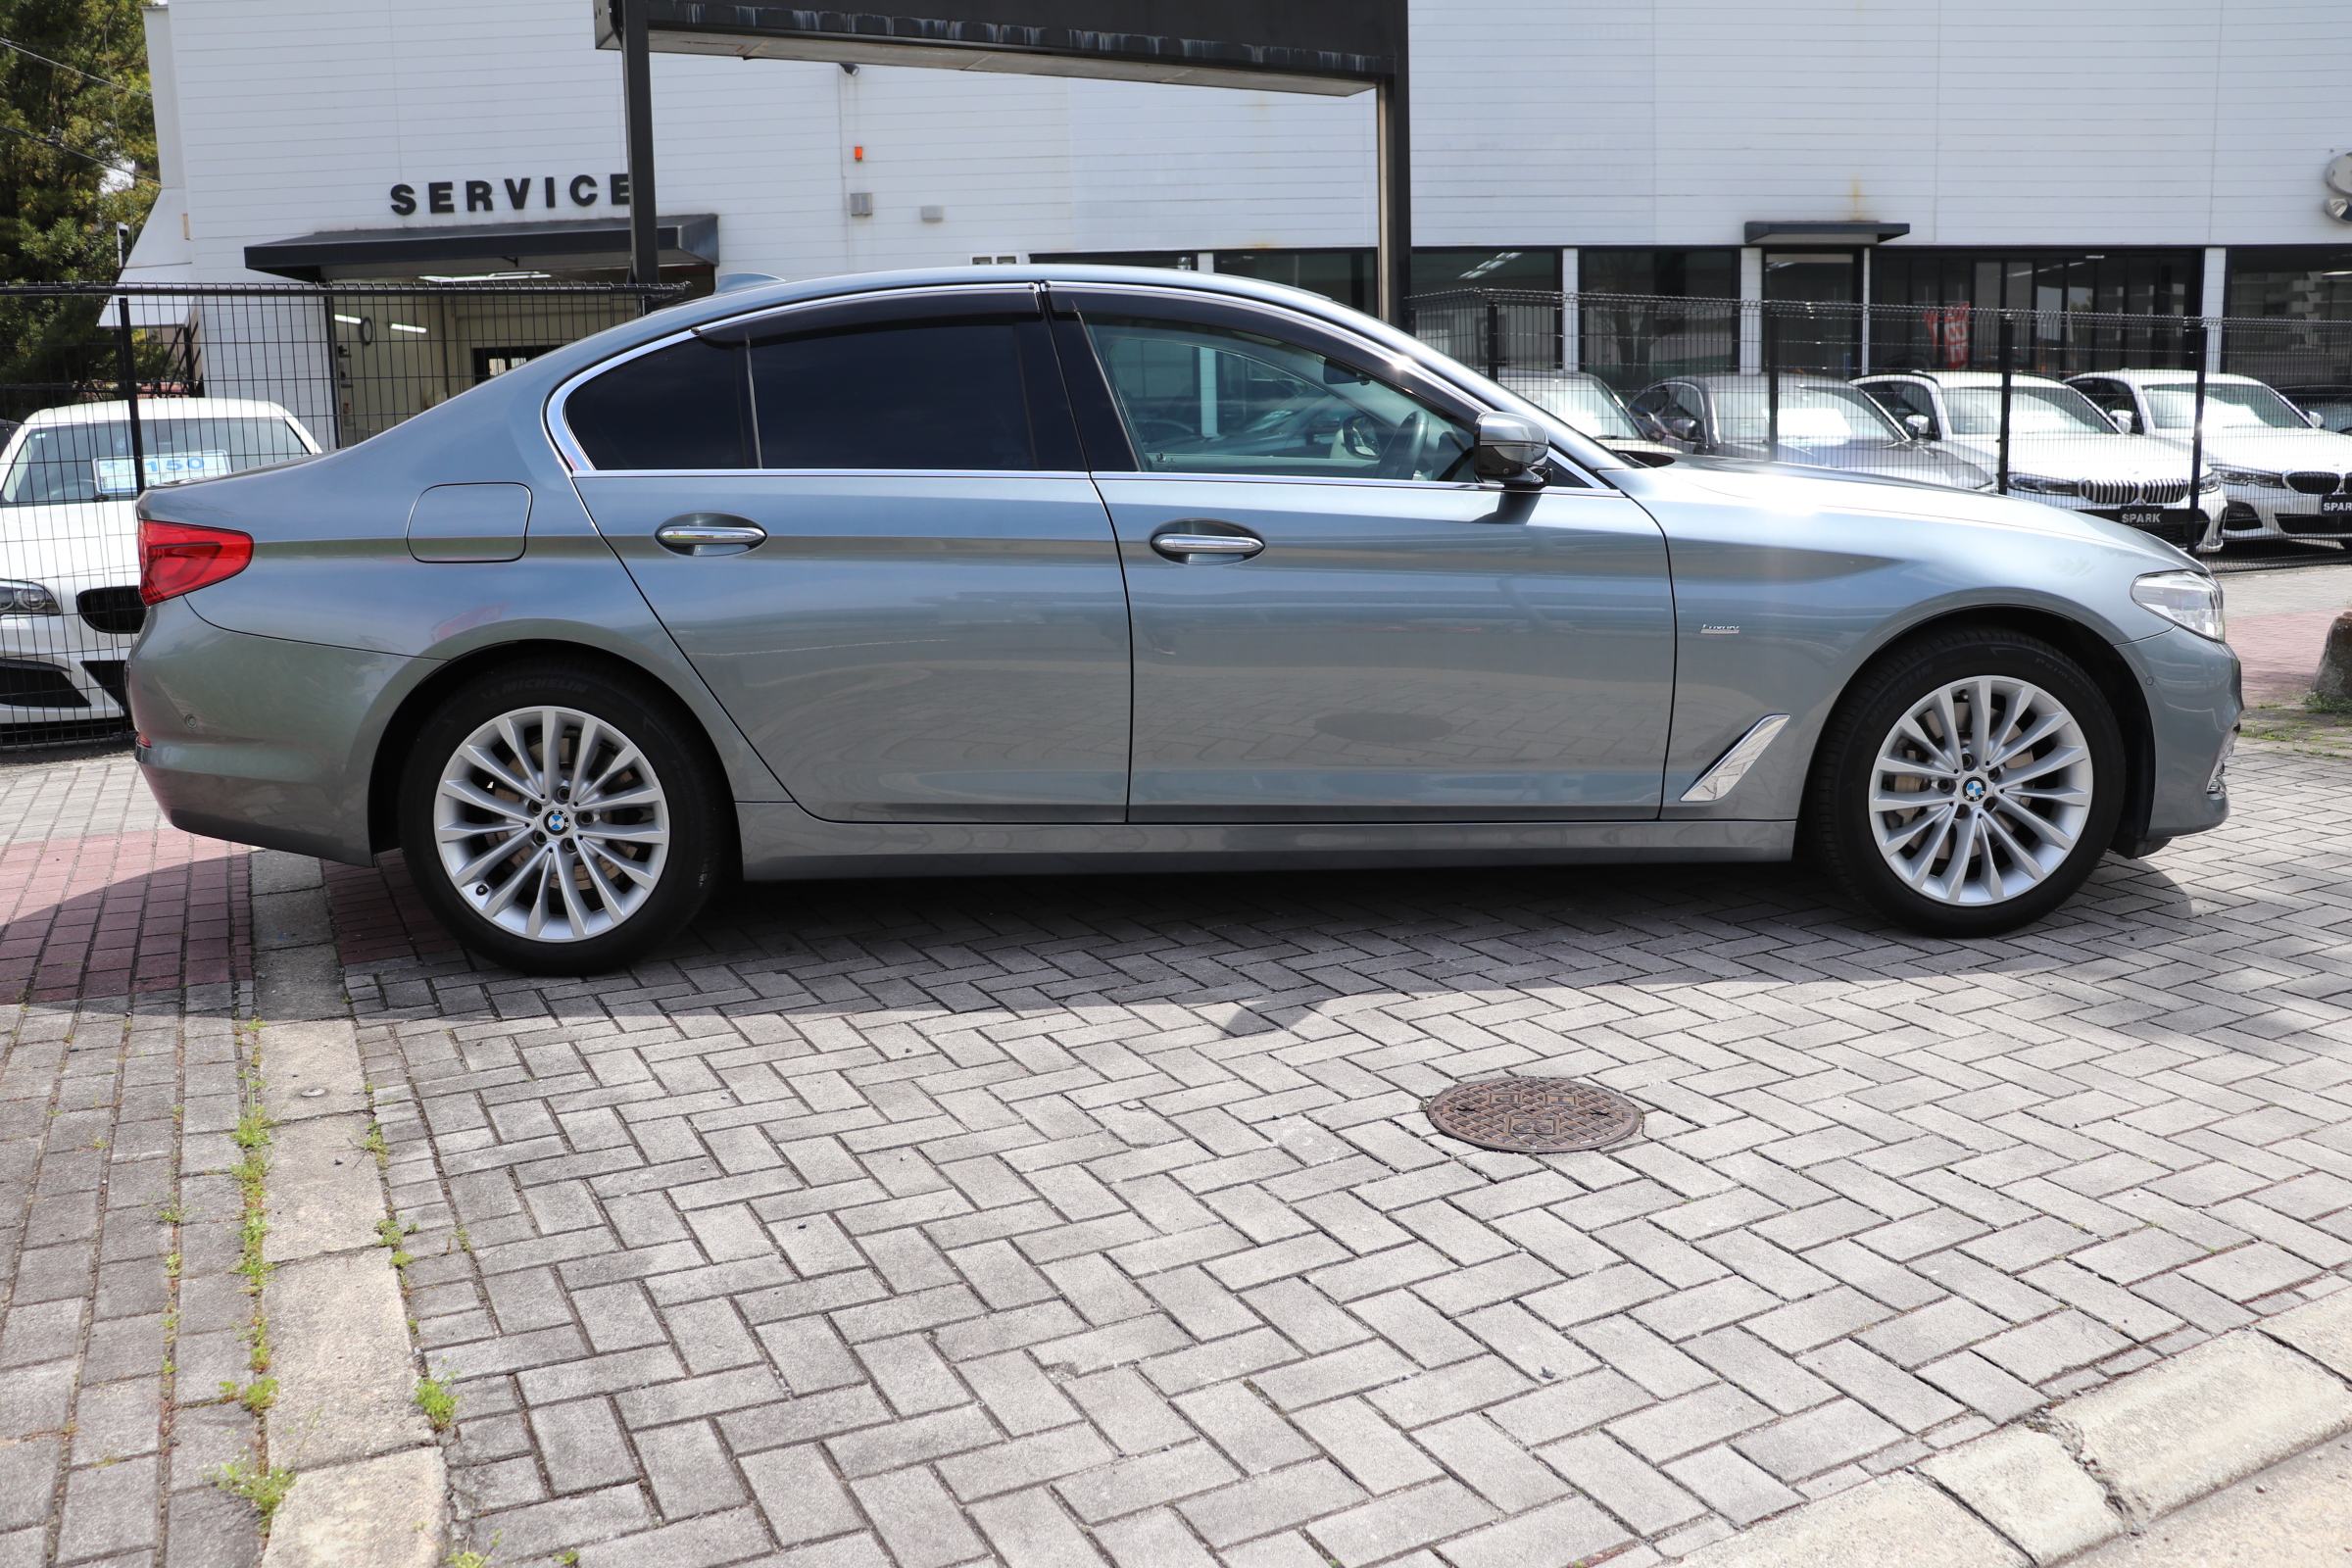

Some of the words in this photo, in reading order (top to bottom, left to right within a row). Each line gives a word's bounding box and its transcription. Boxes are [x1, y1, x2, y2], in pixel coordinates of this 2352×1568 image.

[390, 173, 629, 216] SERVICE
[146, 458, 205, 472] 150
[2122, 513, 2161, 523] SPARK
[502, 678, 590, 695] MICHELIN
[1866, 663, 1933, 728] MICHELIN
